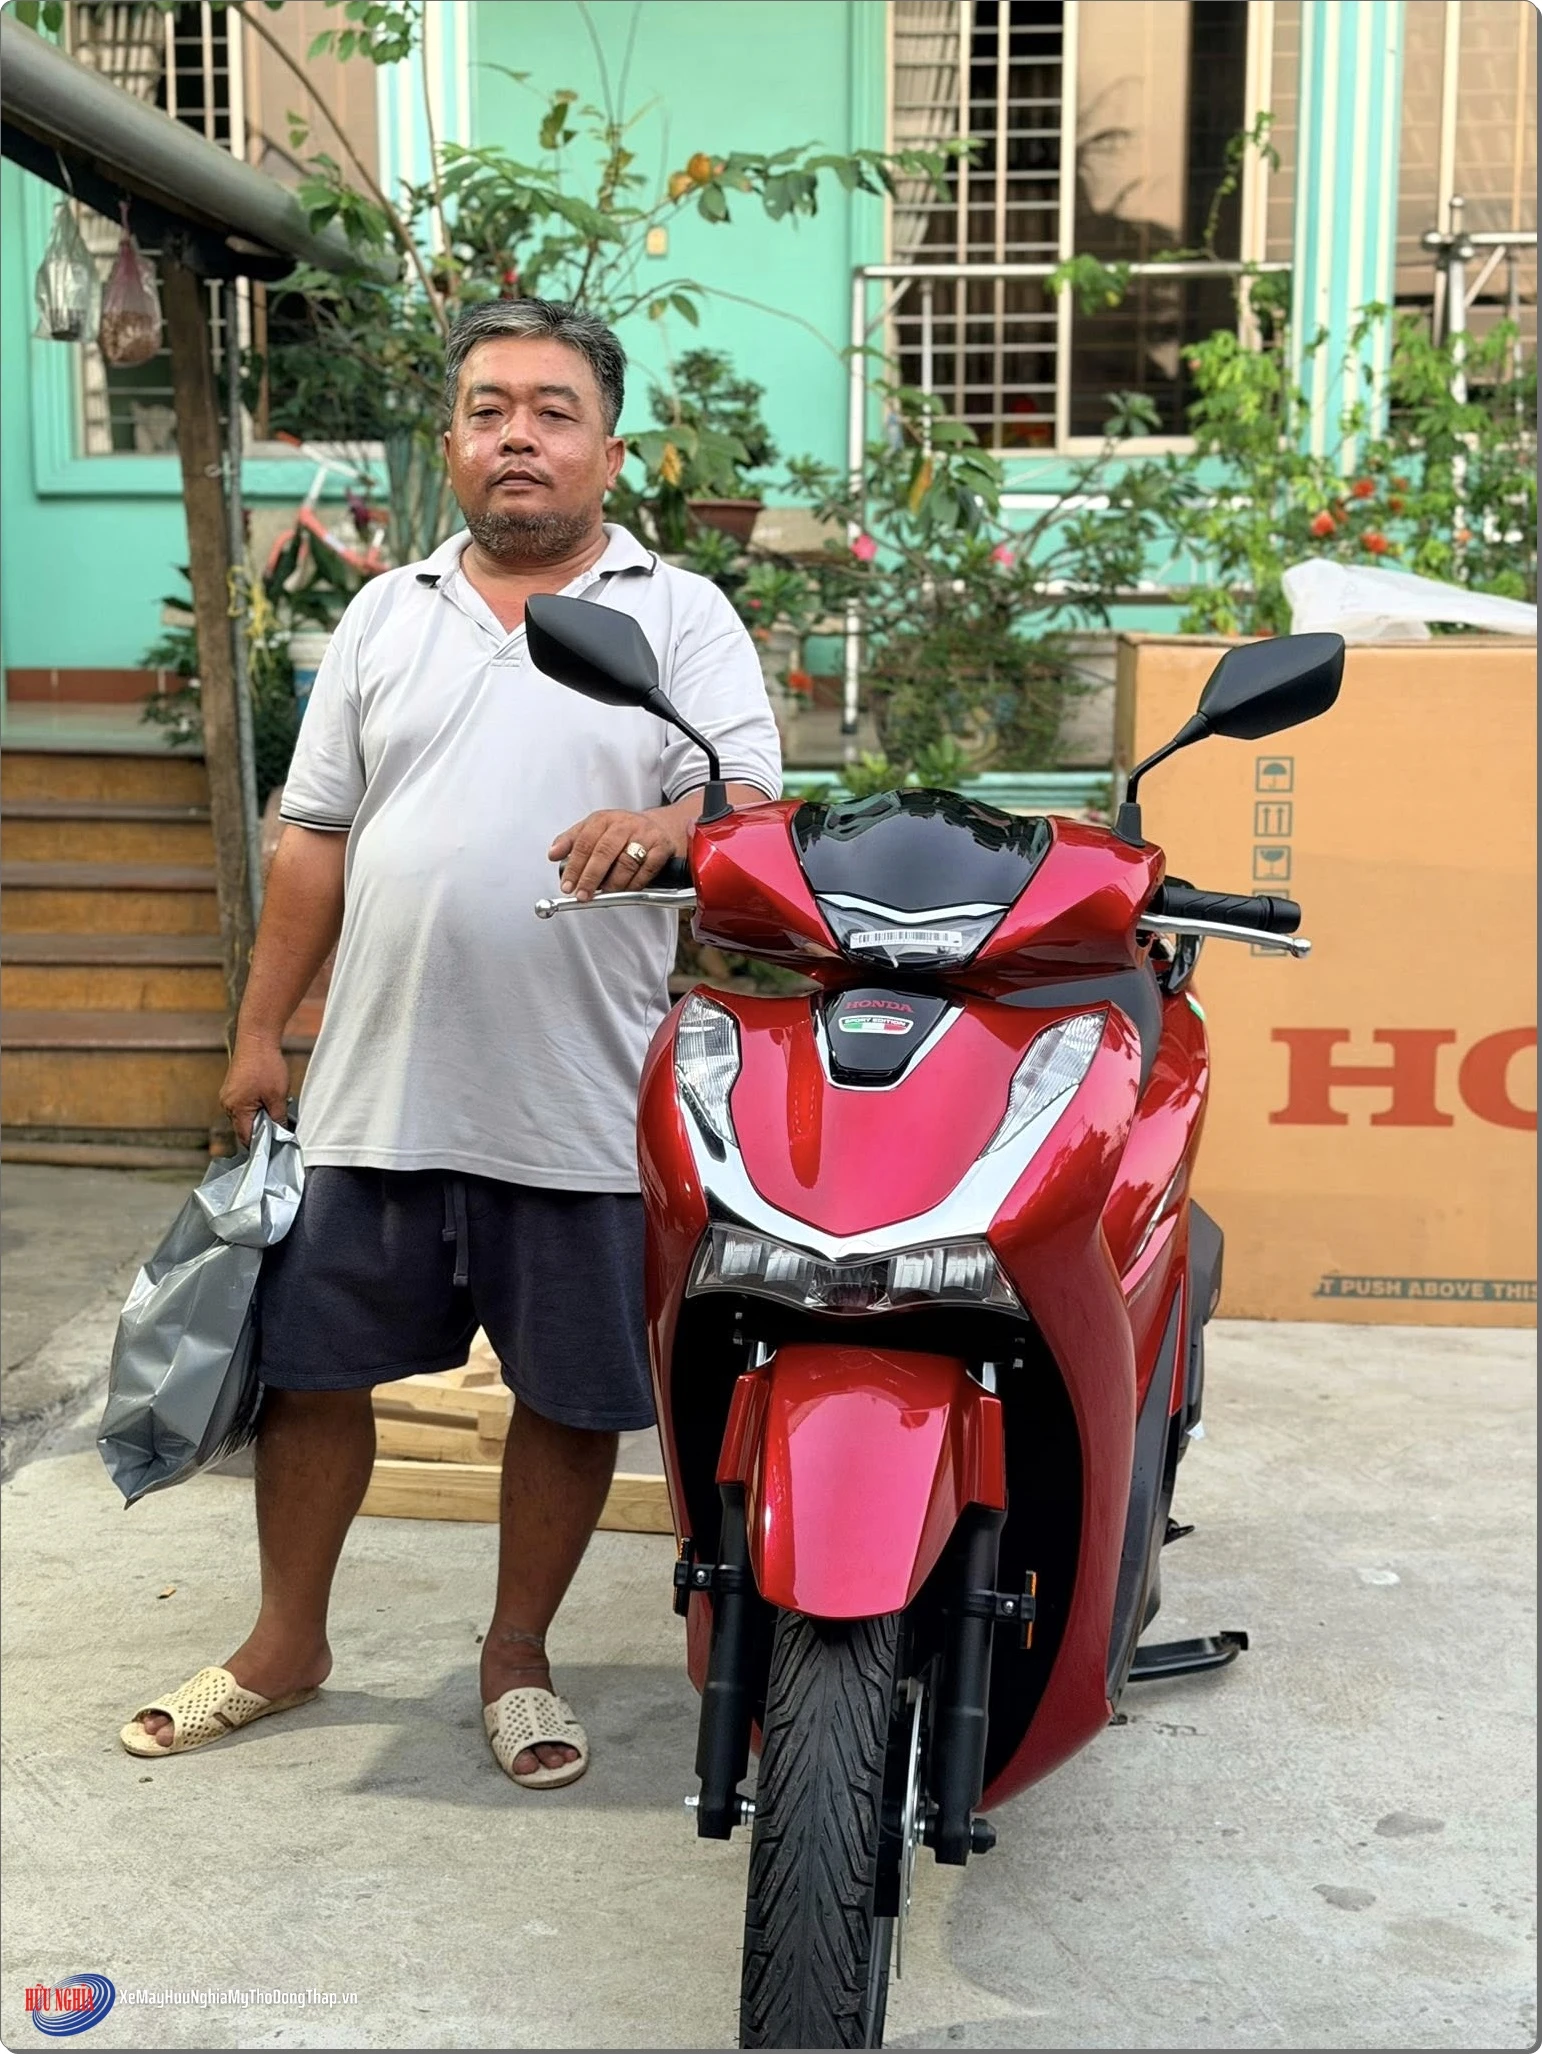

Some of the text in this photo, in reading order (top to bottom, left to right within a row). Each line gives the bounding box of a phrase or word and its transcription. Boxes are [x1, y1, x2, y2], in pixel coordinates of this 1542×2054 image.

[844, 1000, 915, 1013] HONDA
[1340, 1279, 1402, 1296] PUSH
[1408, 1281, 1485, 1298] ABOVE
